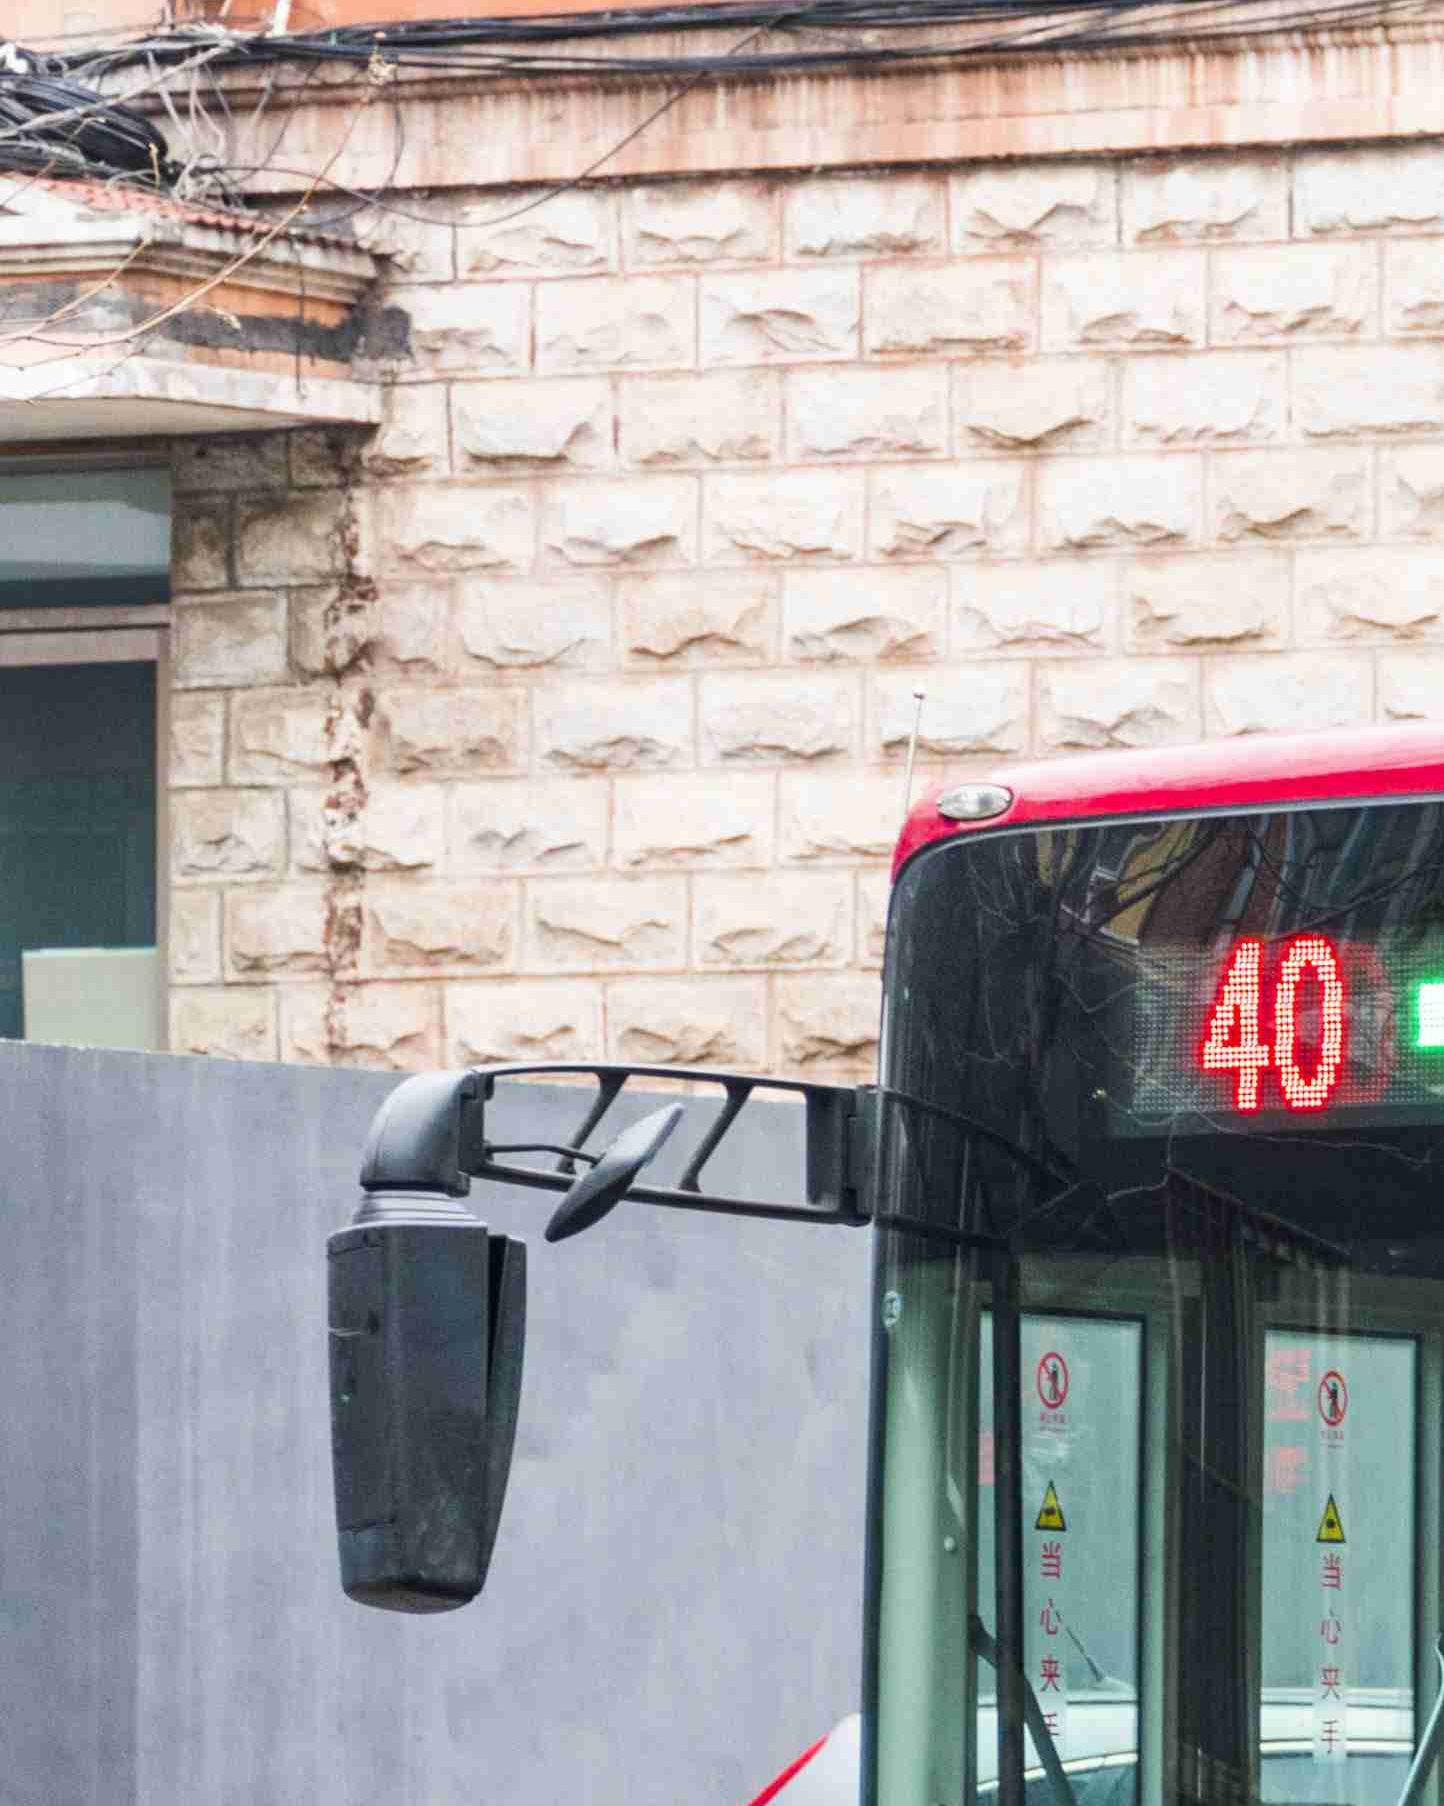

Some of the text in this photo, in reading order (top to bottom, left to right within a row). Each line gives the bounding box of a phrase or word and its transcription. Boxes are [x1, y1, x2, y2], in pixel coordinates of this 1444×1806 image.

[1201, 935, 1345, 1112] 40
[1320, 1553, 1343, 1755] 当心夹手
